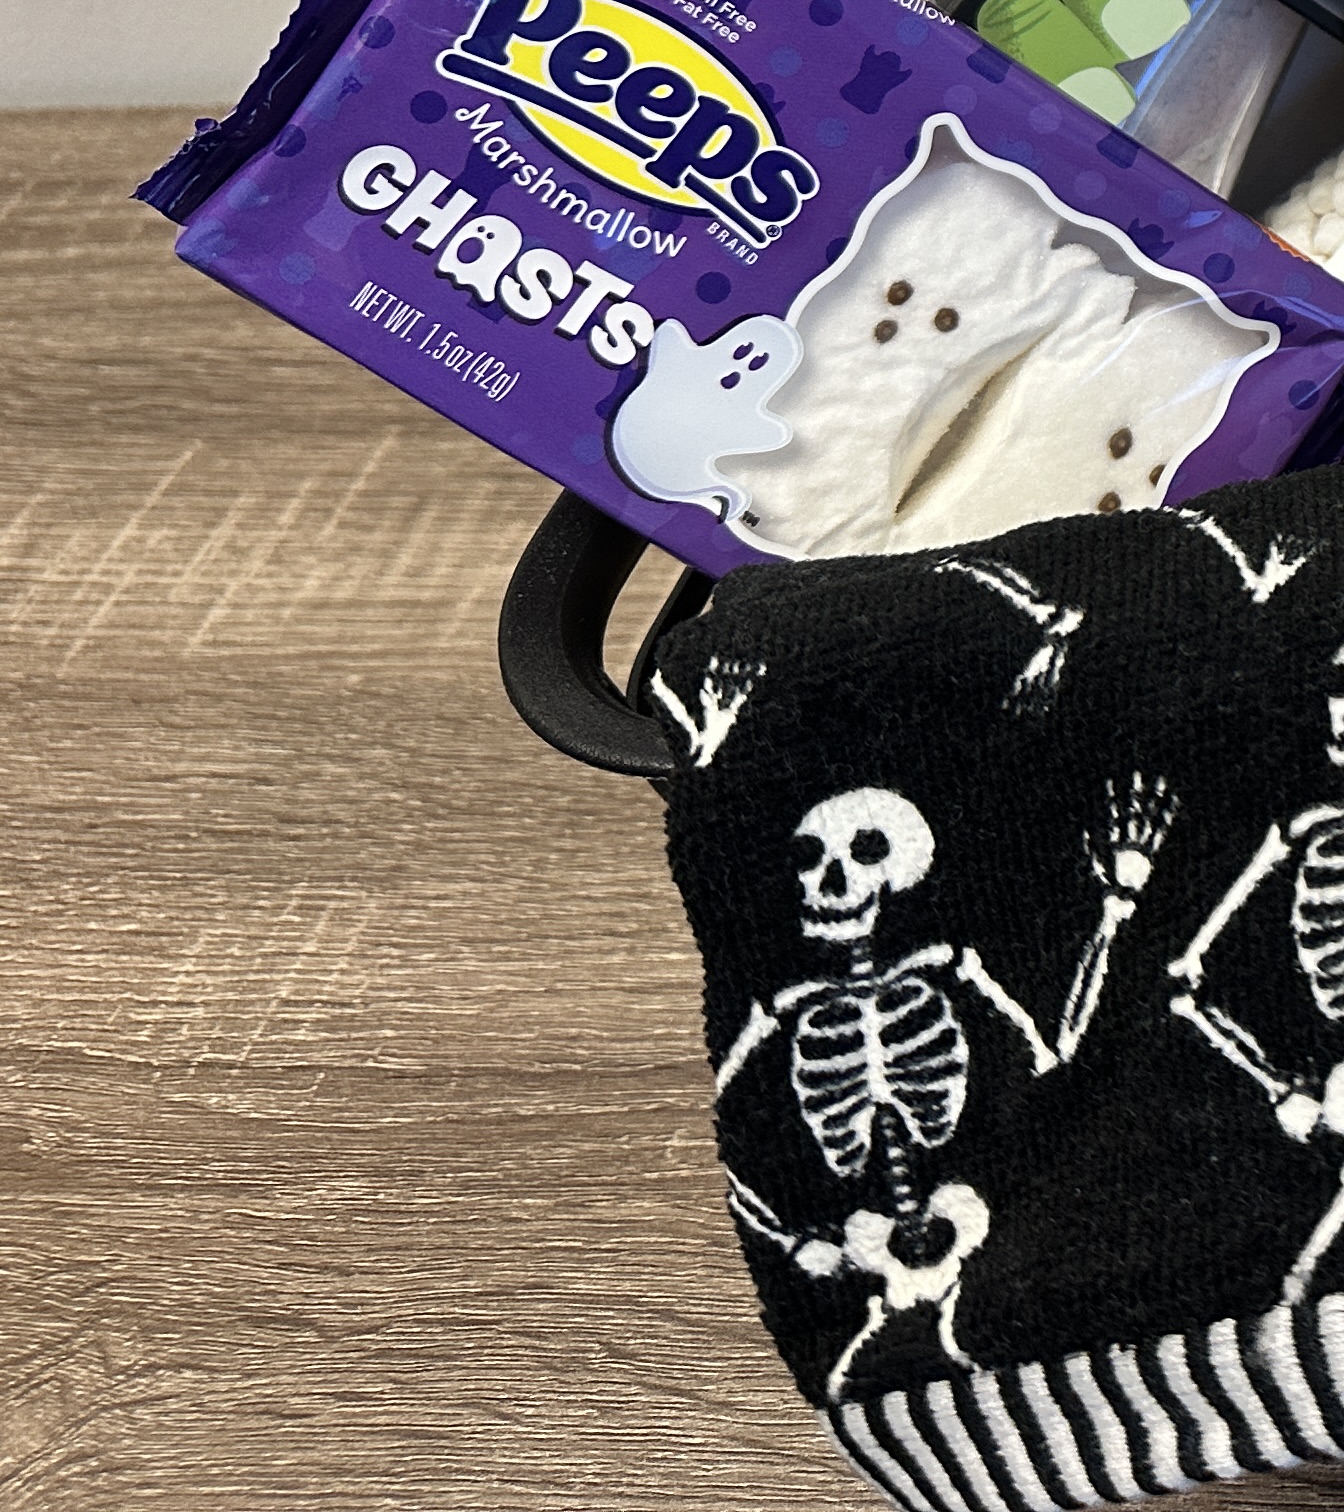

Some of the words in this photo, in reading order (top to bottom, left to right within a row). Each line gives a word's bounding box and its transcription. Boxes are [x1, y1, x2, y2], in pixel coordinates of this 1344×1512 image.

[702, 13, 740, 44] Free
[719, 1, 757, 33] Free
[454, 103, 688, 258] Marshmallow
[706, 220, 760, 266] BRAND
